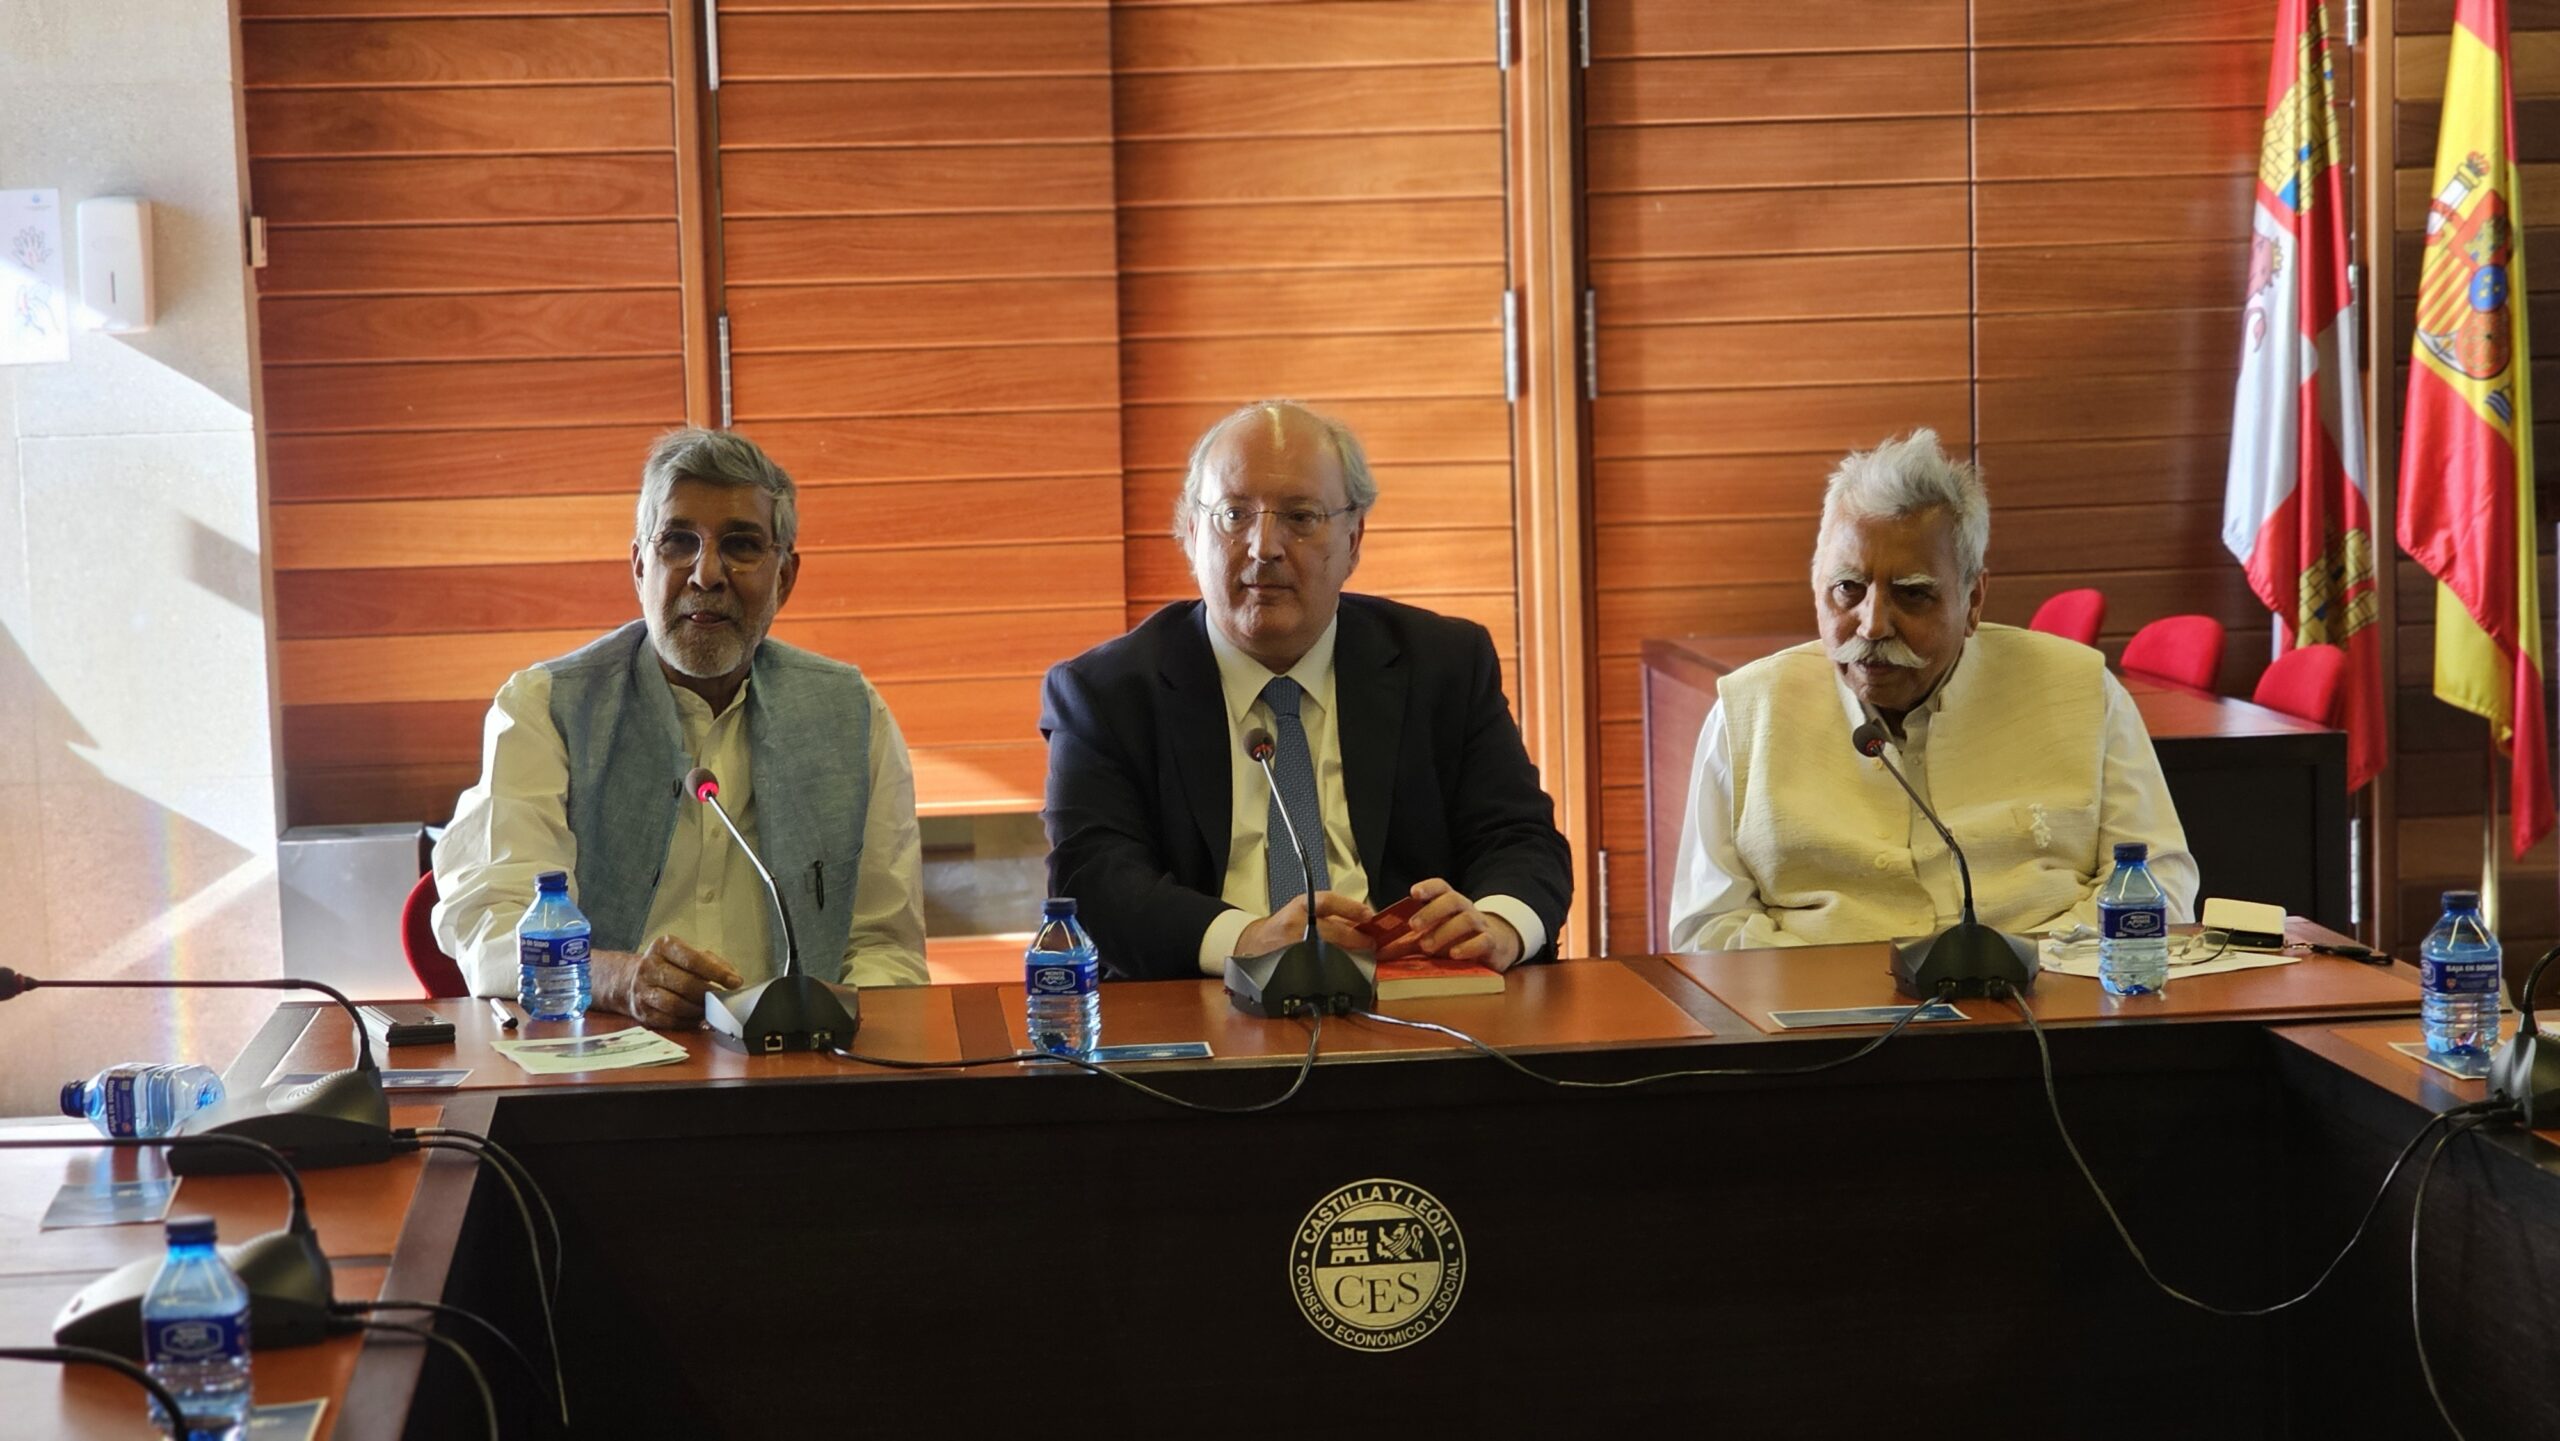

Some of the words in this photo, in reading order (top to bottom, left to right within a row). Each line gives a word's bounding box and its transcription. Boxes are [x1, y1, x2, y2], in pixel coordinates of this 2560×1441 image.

[1302, 1185, 1384, 1244] CASTILLA
[1388, 1186, 1402, 1202] Y
[1404, 1192, 1452, 1237] LEÓN
[1296, 1264, 1335, 1329] CONSEJO
[1334, 1320, 1427, 1347] ECONÓMICO
[1425, 1309, 1437, 1322] Y
[1434, 1257, 1460, 1312] SOCIAL
[1333, 1271, 1420, 1315] CES
